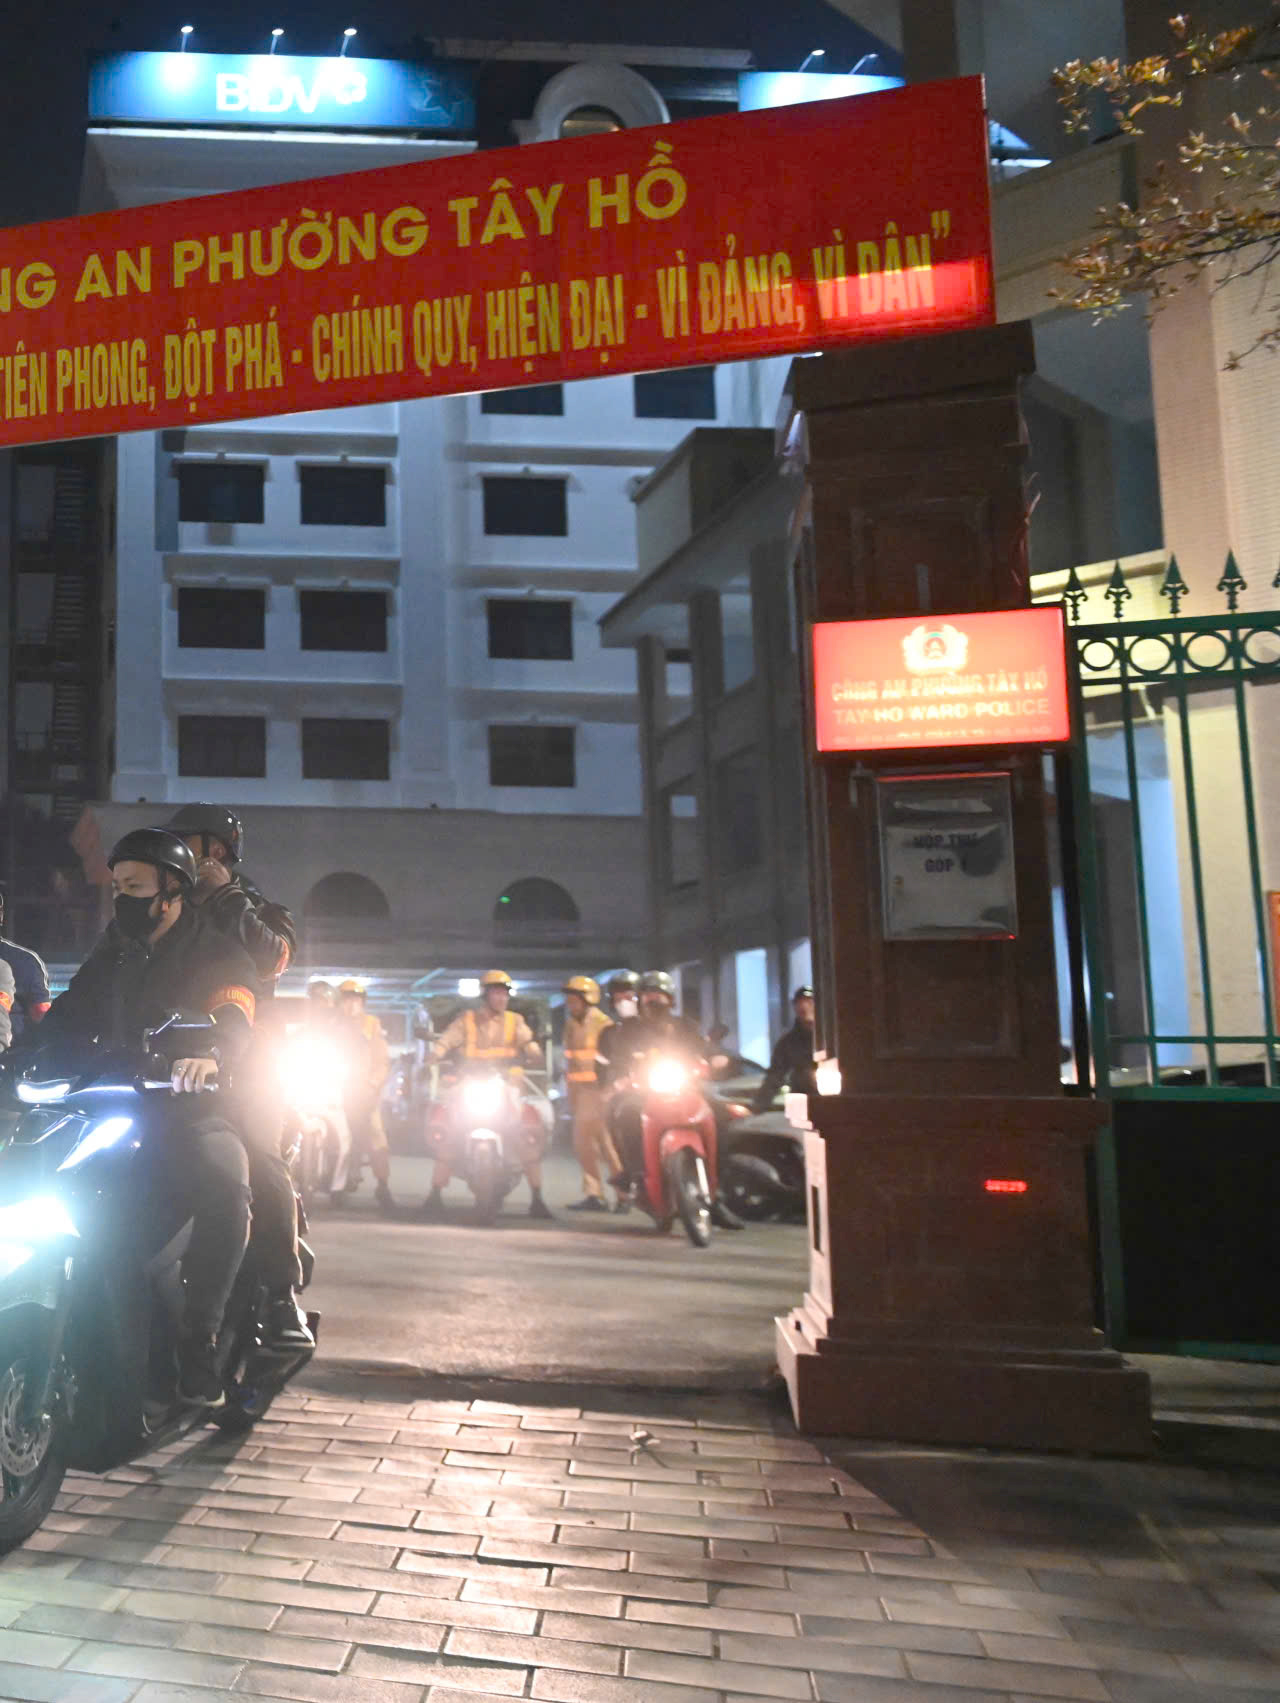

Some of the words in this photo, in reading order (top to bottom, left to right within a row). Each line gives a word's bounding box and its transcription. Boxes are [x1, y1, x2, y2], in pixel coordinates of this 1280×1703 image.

[74, 245, 152, 303] AN
[172, 205, 430, 289] PHƯỜNG
[448, 177, 564, 247] TÂY
[587, 139, 688, 229] HỒ
[56, 337, 156, 411] PHONG,
[164, 316, 217, 413] ĐỘT
[225, 306, 284, 392] PHÁ
[311, 295, 404, 382] CHÍNH
[413, 293, 478, 377] QUY,
[486, 271, 561, 373] HIỆN
[569, 273, 626, 364] ĐẠI
[656, 250, 691, 339] VÌ
[699, 232, 806, 333] ĐẢNG,
[811, 227, 849, 320] VÌ
[856, 209, 951, 316] DÂN”
[975, 698, 1050, 717] POLICE
